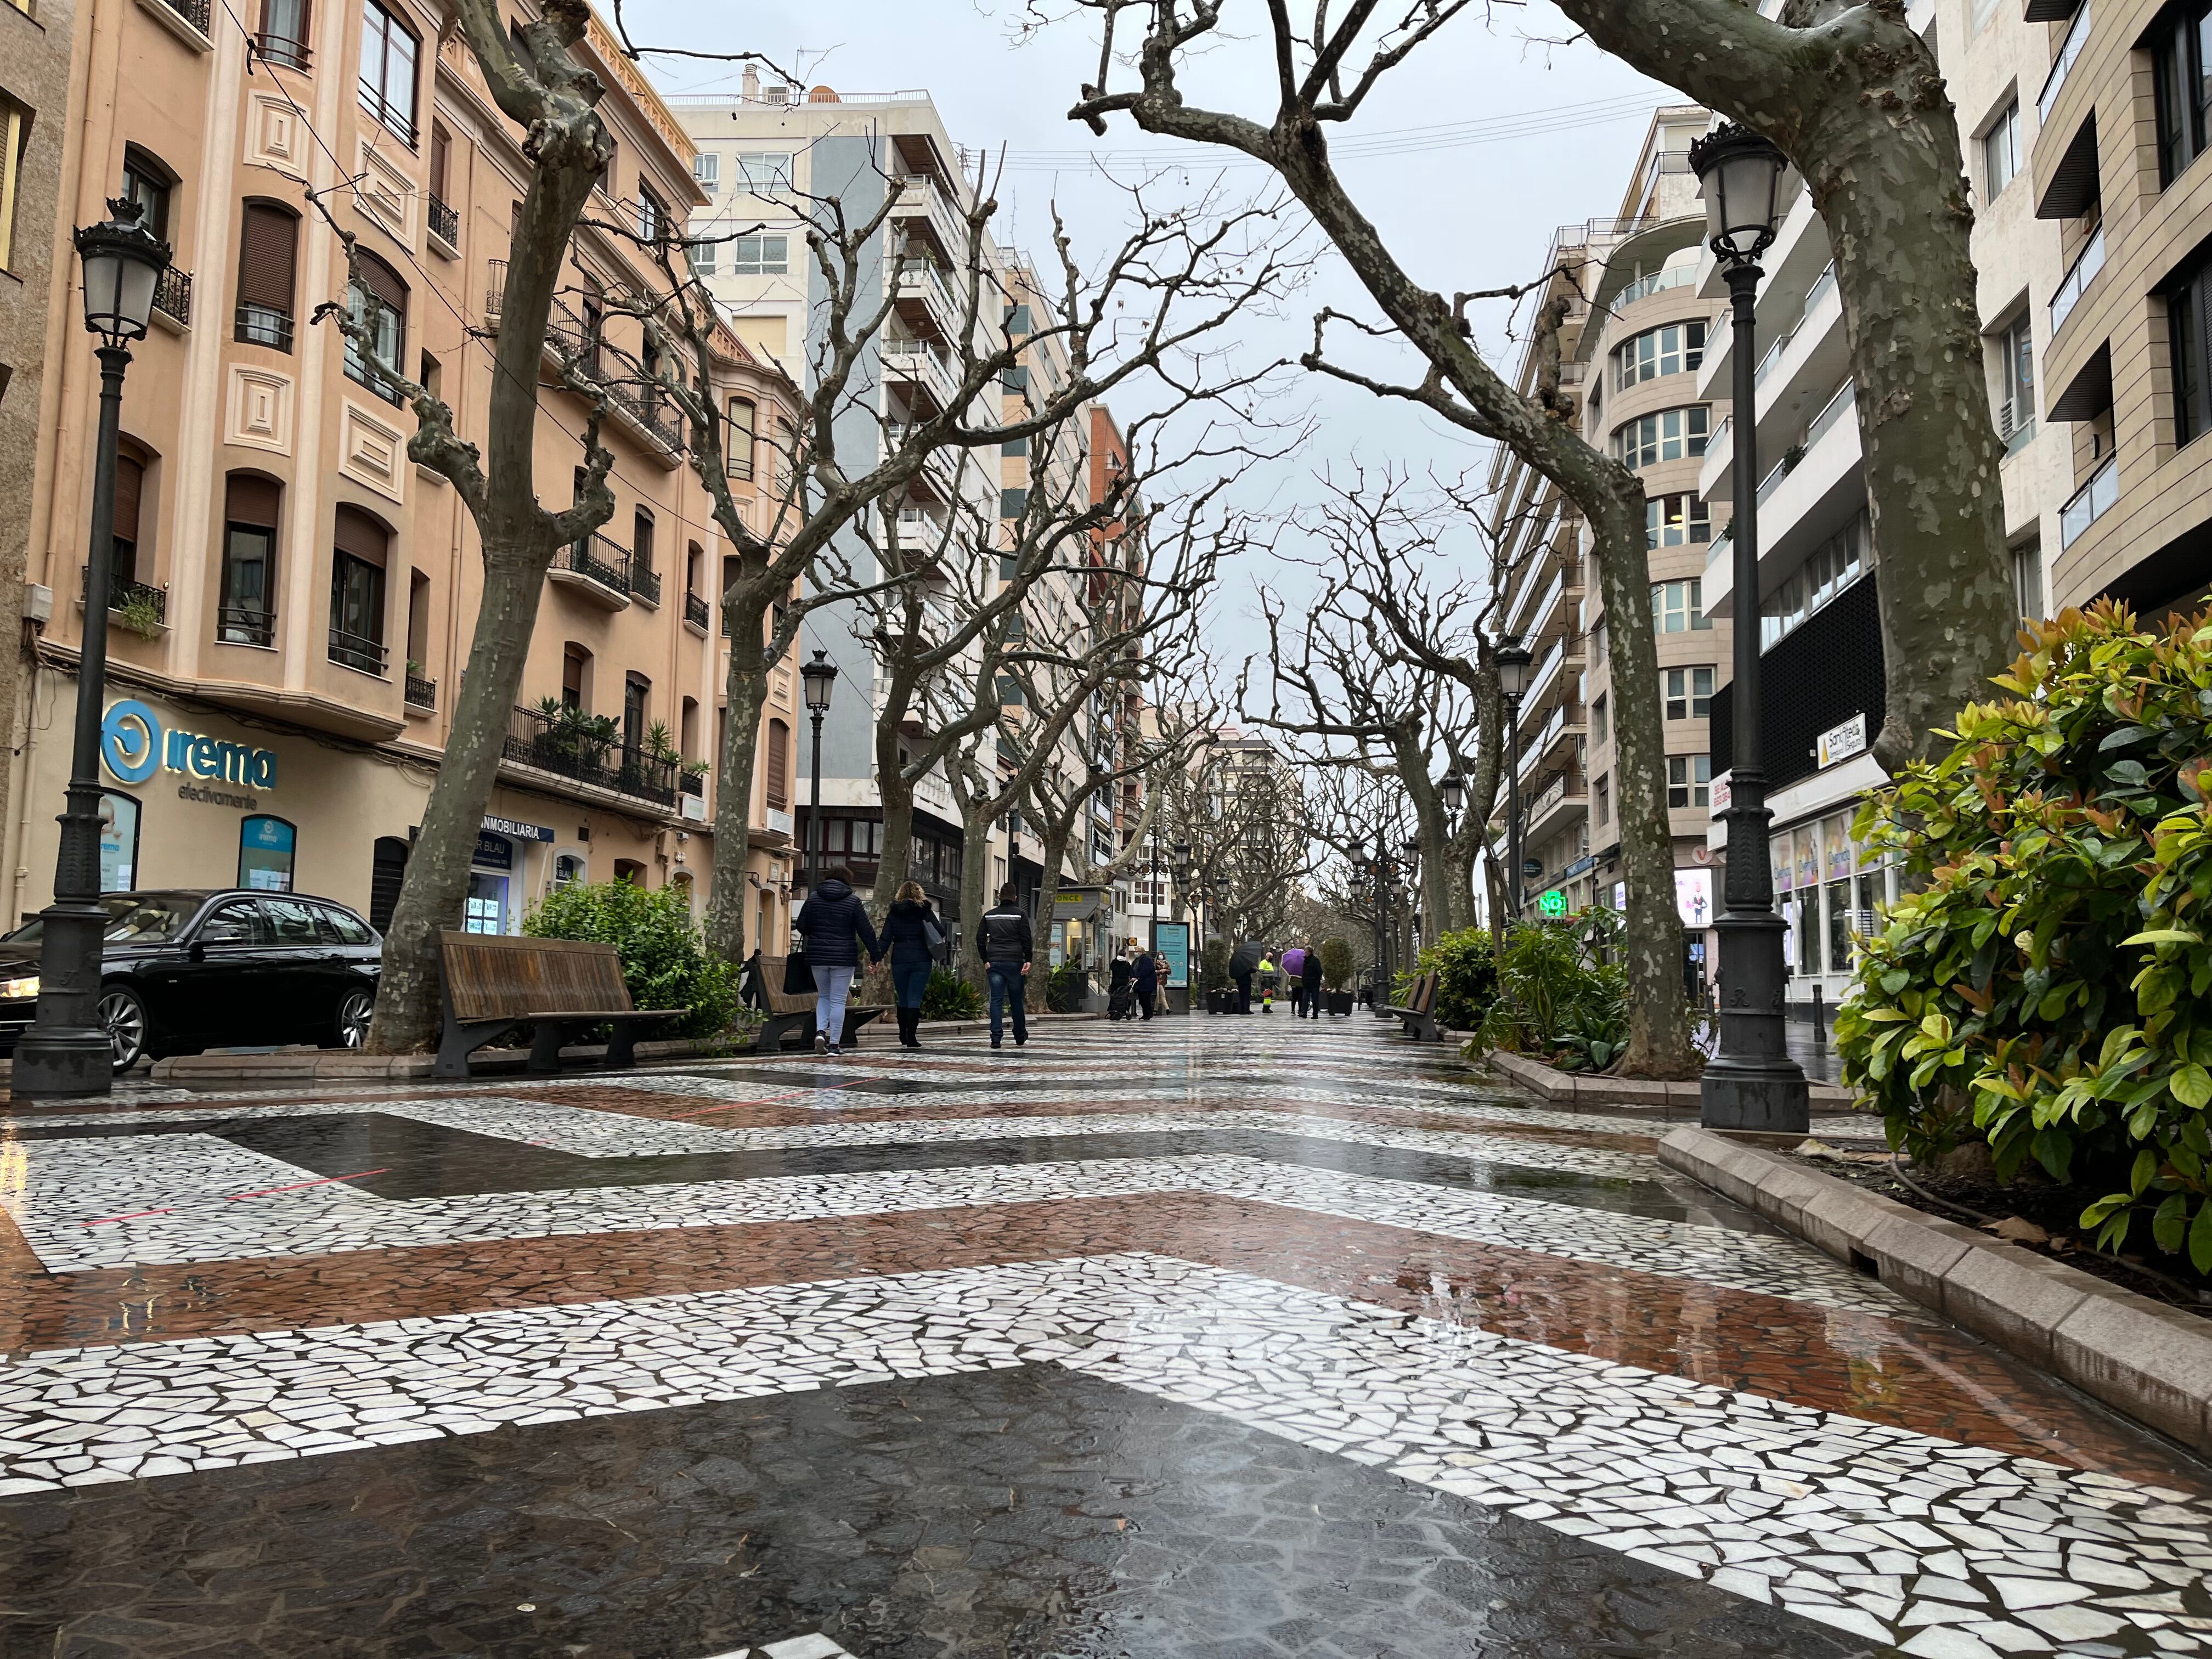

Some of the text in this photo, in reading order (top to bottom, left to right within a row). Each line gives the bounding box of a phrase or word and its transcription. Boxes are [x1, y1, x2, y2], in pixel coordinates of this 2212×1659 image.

[178, 782, 257, 810] efectivamente
[100, 843, 120, 851] rema
[484, 840, 505, 854] BLAU
